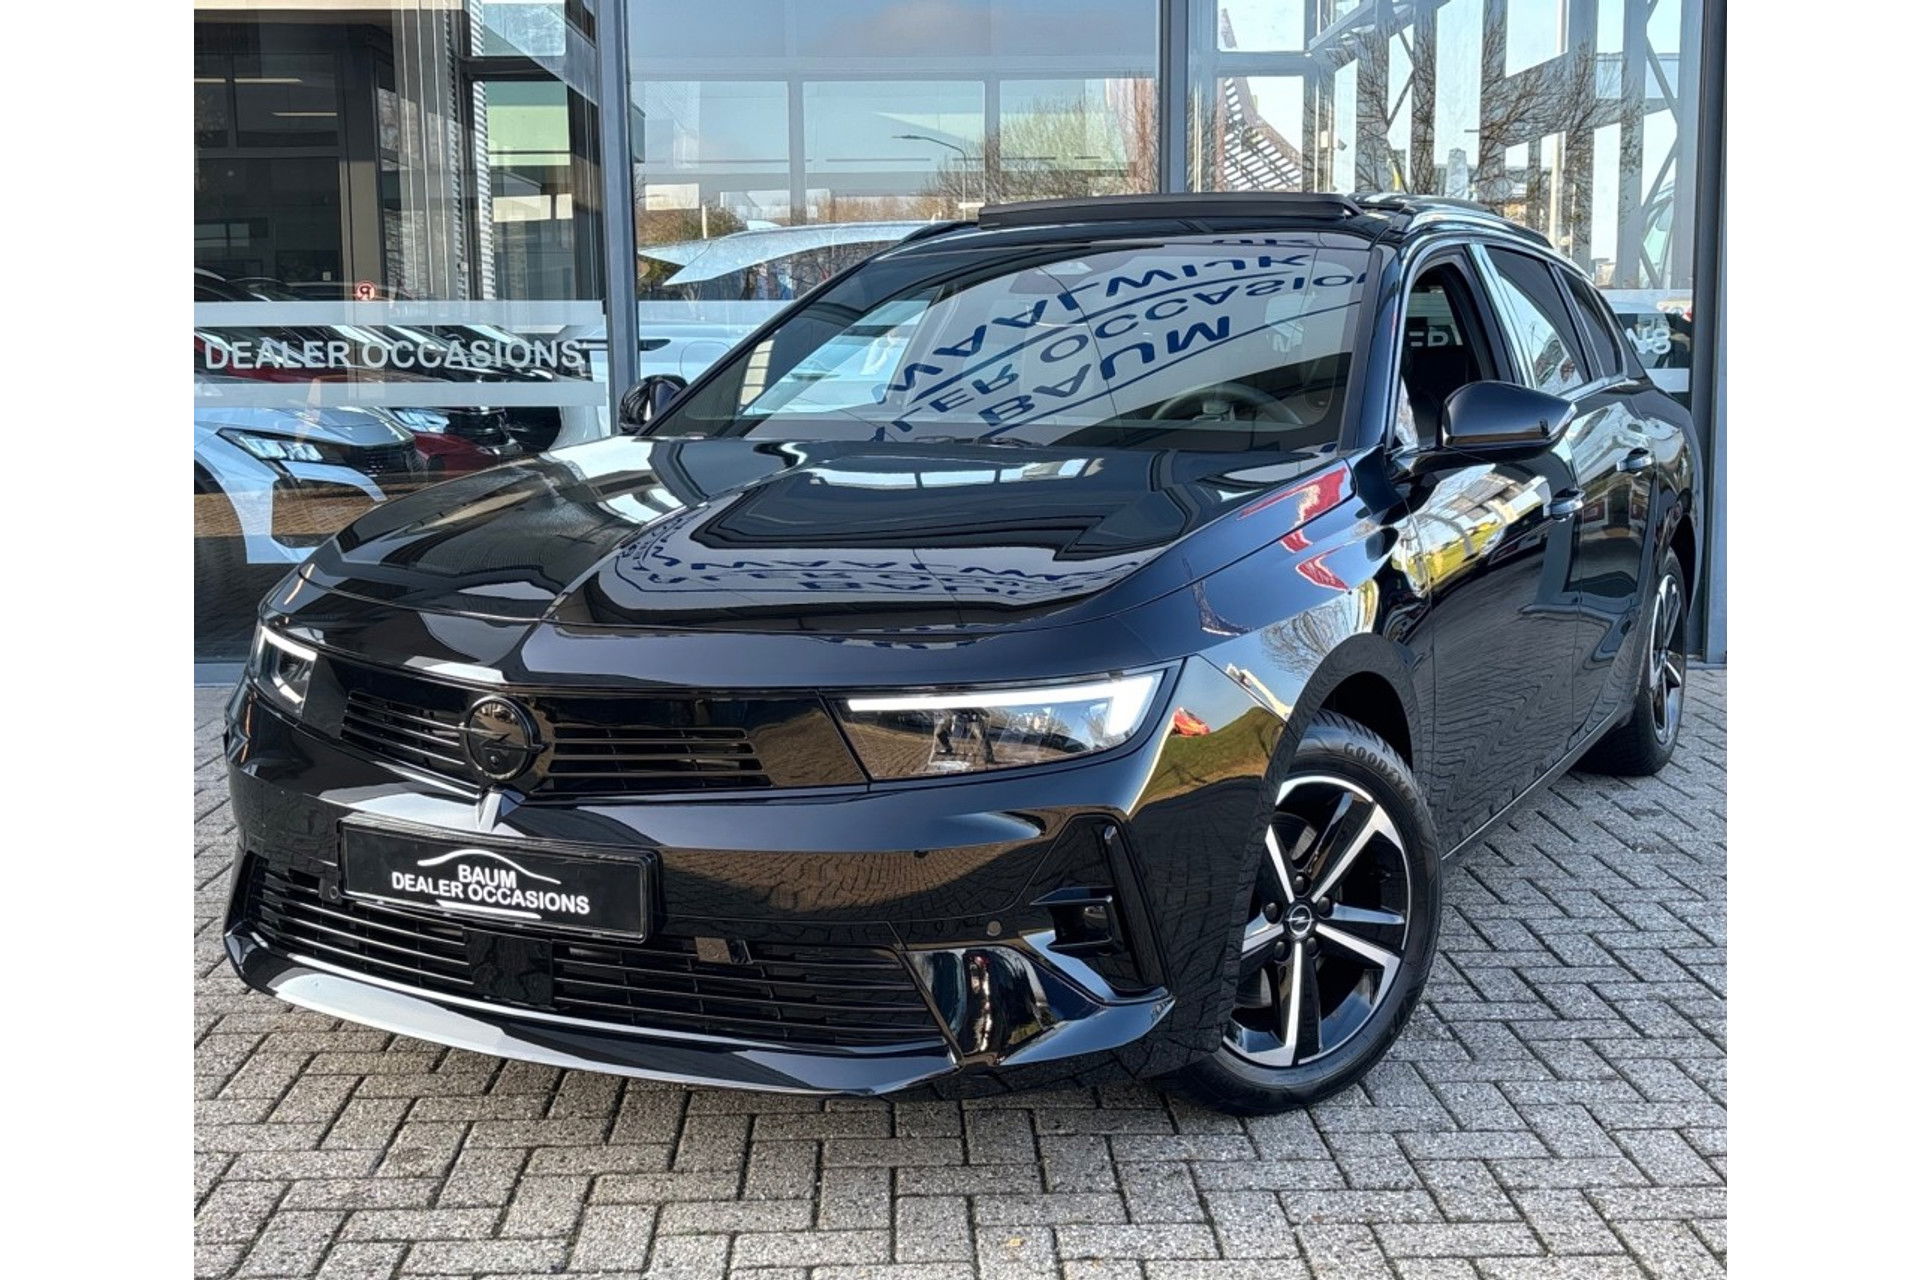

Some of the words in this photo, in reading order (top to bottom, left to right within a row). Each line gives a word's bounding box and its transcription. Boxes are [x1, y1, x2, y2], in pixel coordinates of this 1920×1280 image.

[205, 340, 349, 370] DEALER
[361, 339, 584, 370] OCCASIONS
[457, 864, 517, 889] BAUM
[391, 870, 464, 899] DEALER
[467, 884, 590, 915] OCCASIONS
